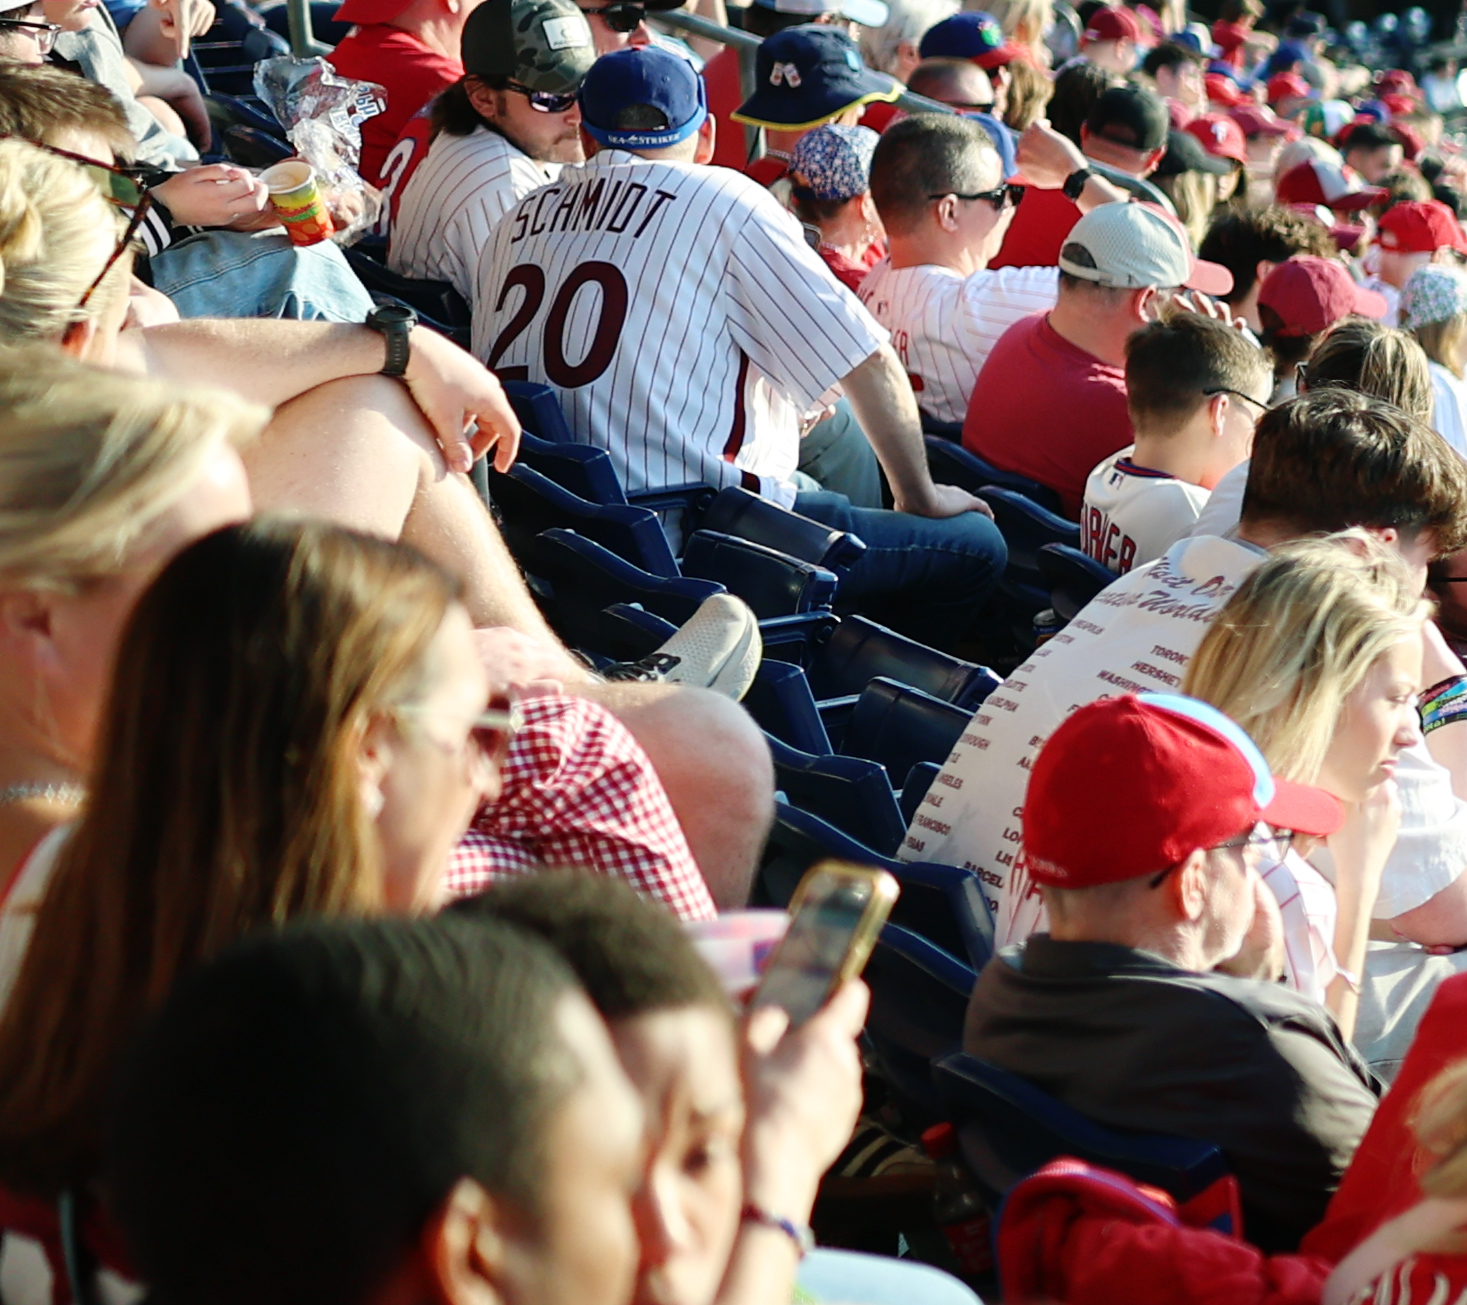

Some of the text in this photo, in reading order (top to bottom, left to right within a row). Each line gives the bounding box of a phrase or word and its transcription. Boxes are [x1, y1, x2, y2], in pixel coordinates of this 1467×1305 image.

[607, 132, 681, 146] SEA STRIKER
[510, 179, 677, 245] SCHMIDT
[487, 260, 629, 390] 20
[1149, 644, 1190, 666] TORON
[964, 860, 1005, 889] BARCEL
